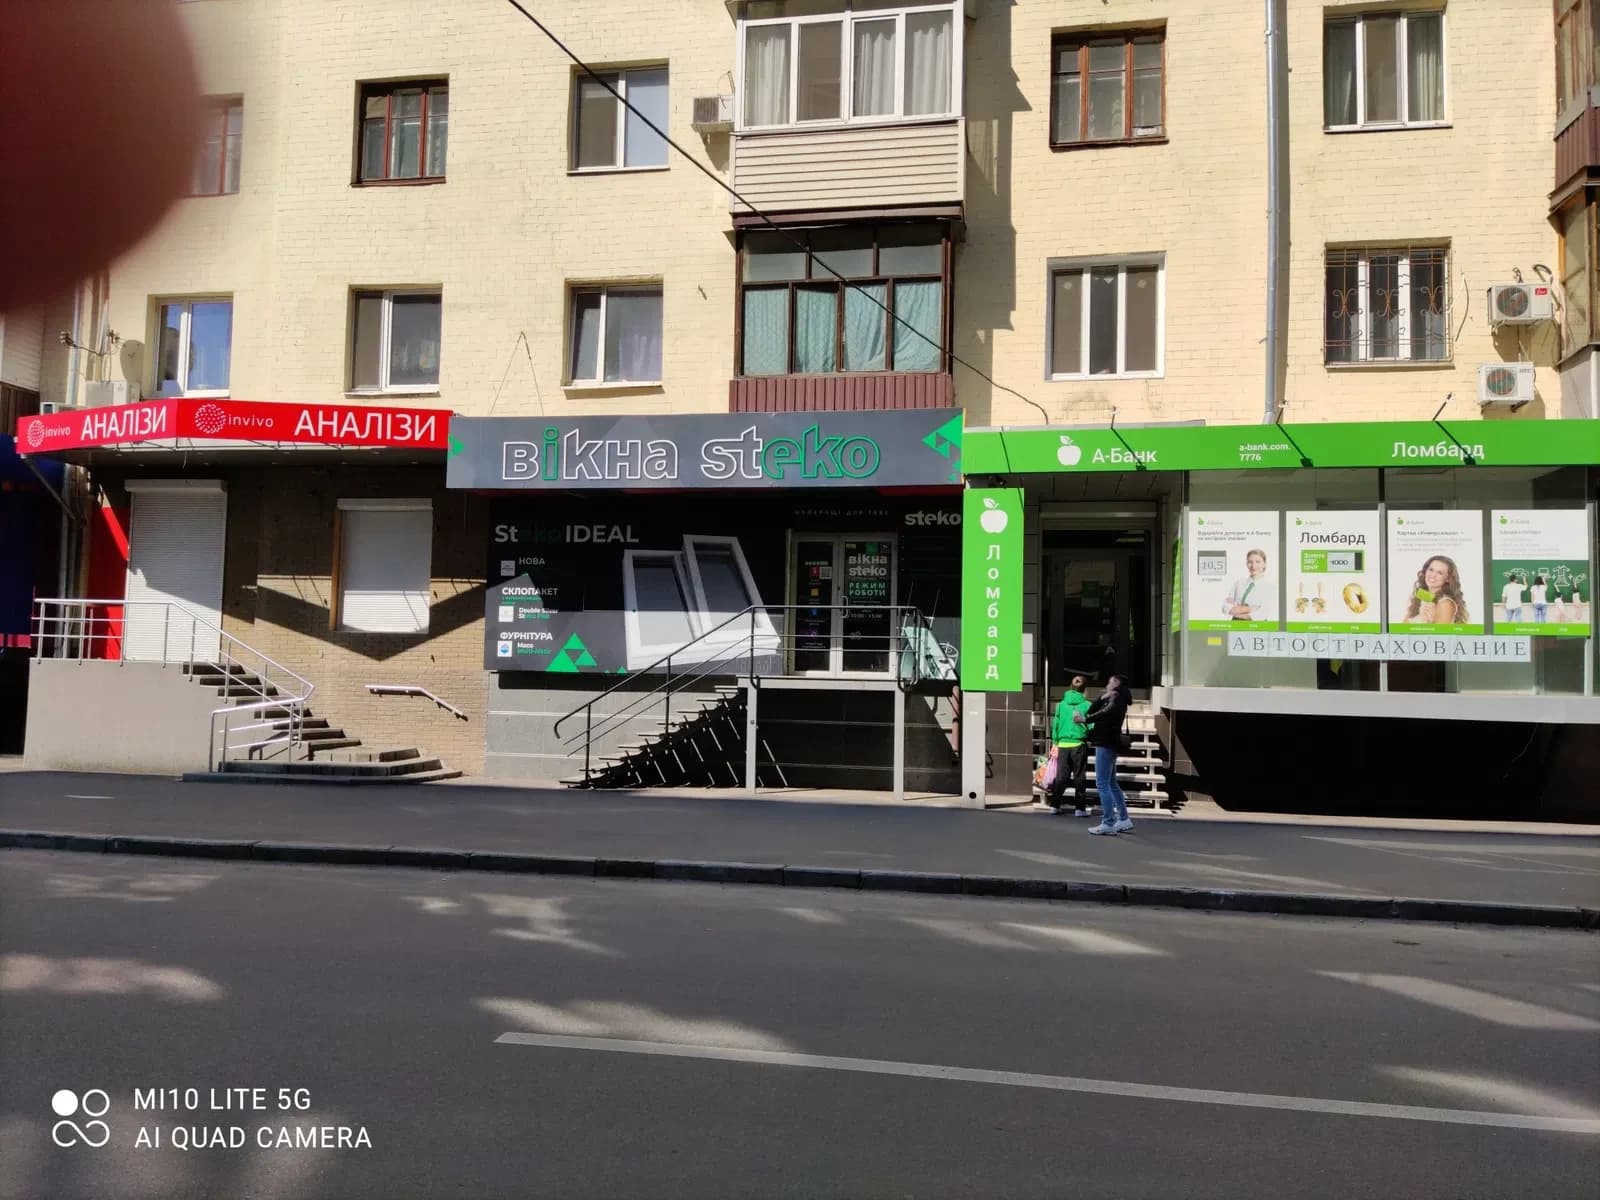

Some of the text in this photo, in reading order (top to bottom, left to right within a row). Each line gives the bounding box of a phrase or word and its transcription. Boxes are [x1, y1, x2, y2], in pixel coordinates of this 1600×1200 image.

[80, 405, 167, 441] АНАЛІЗИ
[228, 414, 274, 428] invivo
[294, 409, 436, 442] АНАЛІЗИ
[45, 425, 71, 438] invivo
[700, 424, 881, 480] steko
[1239, 453, 1262, 462] 7776
[1391, 440, 1485, 461] Ломбард
[904, 510, 961, 526] steko
[565, 524, 640, 543] IDEAL
[1299, 531, 1366, 546] Ломбард
[518, 557, 546, 566] НОВА
[848, 565, 888, 577] steko
[501, 587, 559, 596] СКЛОПАКЕТ
[849, 582, 886, 590] РЕЖИМ
[849, 589, 886, 597] РОБОТИ
[985, 544, 1001, 680] Ломбард
[499, 631, 553, 640] ФУРНІТУРА
[1232, 636, 1527, 656] АВТОСТРАХОВАНИЕ
